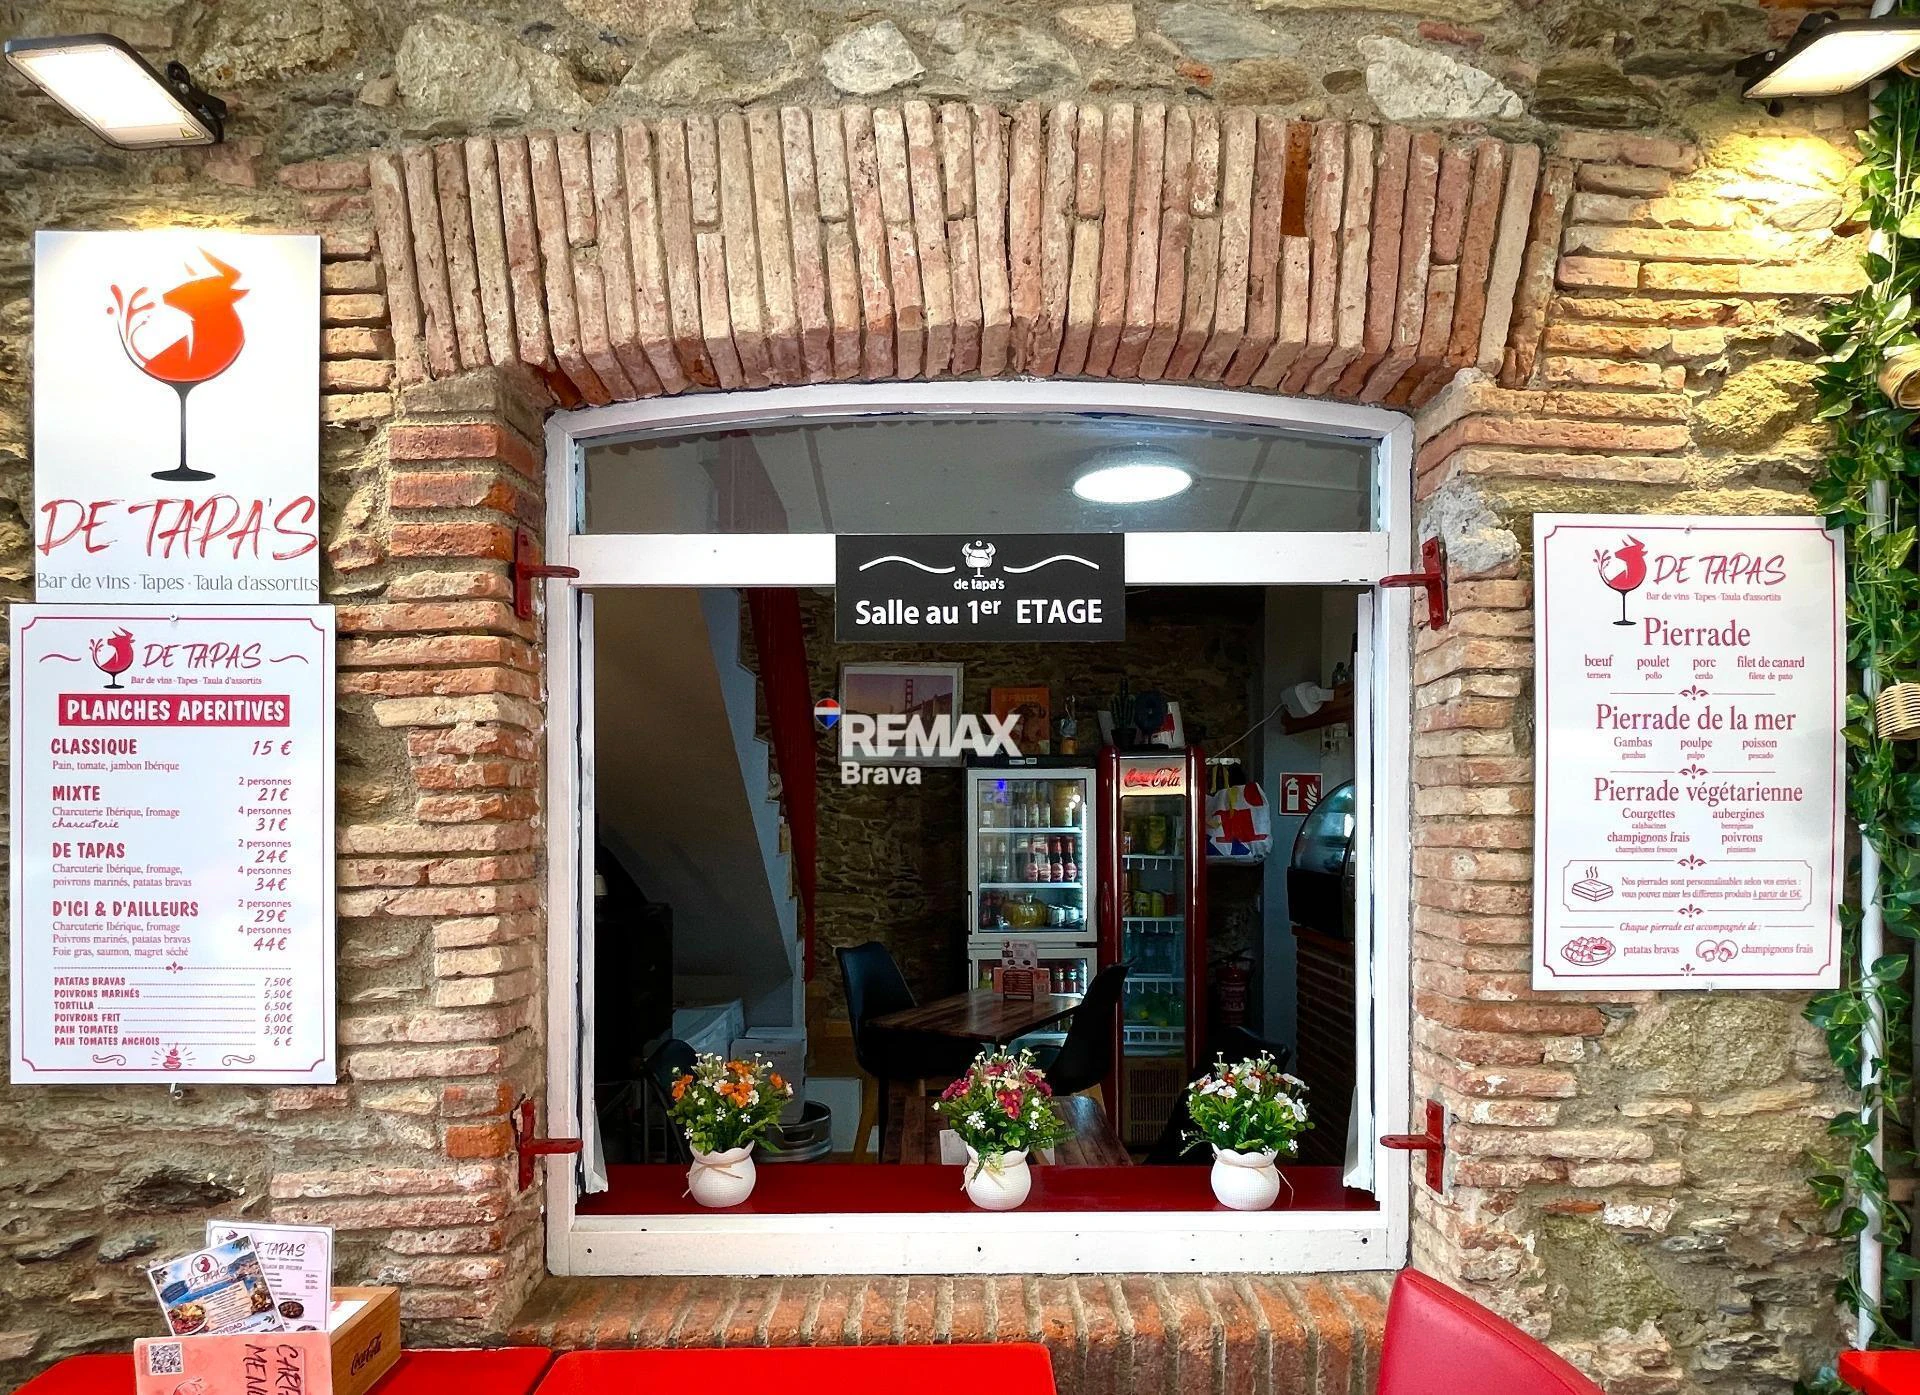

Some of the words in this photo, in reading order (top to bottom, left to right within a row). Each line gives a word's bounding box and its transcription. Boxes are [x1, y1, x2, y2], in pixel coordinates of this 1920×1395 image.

[37, 498, 125, 556] DE
[128, 494, 318, 560] TAPA'S
[1653, 554, 1695, 585] DE
[1698, 552, 1787, 586] TAPAS
[37, 573, 67, 589] Bar
[72, 573, 91, 590] de
[96, 574, 130, 590] vins
[138, 573, 184, 593] Tapes
[194, 574, 233, 591] Taula
[238, 575, 319, 592] d'assortits
[953, 578, 969, 590] de
[971, 578, 1005, 591] tapa's
[1646, 592, 1660, 600] Bar
[1661, 592, 1672, 600] de
[1673, 592, 1690, 600] vins
[1694, 592, 1716, 602] Tapes
[1720, 593, 1741, 601] Taula
[1742, 593, 1781, 601] d'assortits
[855, 600, 919, 625] Salle
[926, 605, 959, 624] au
[967, 599, 1002, 624] 1er
[1016, 599, 1103, 624] ETAGE
[1643, 617, 1750, 647] Pierrade
[143, 644, 178, 668] DE
[183, 642, 262, 669] TAPAS
[1637, 655, 1669, 669] poulet
[1693, 657, 1716, 669] porc
[1737, 656, 1756, 667] filet
[1758, 656, 1770, 668] de
[1772, 656, 1805, 668] canard
[131, 676, 144, 685] Bar
[146, 676, 155, 685] de
[157, 677, 172, 685] vins
[177, 677, 198, 686] Tapes
[203, 677, 223, 686] Taula
[225, 677, 262, 686] d'assortits
[1645, 672, 1662, 680] pollo
[1749, 672, 1766, 680] filete
[1768, 672, 1776, 680] de
[67, 699, 170, 721] PLANCHES
[178, 699, 285, 721] APERITIVES
[1596, 704, 1690, 730] Pierrade
[1697, 705, 1723, 730] de
[1730, 706, 1747, 730] la
[1754, 712, 1796, 730] mer
[51, 738, 137, 755] CLASSIQUE
[252, 740, 273, 755] 15
[281, 740, 292, 755] €
[1614, 737, 1652, 747] Gambas
[1680, 738, 1713, 750] poulpe
[1742, 738, 1777, 750] poisson
[52, 761, 75, 771] Pain,
[77, 761, 108, 771] tomate,
[109, 761, 142, 771] jambon
[144, 760, 180, 771] Ibérique
[239, 777, 244, 785] 2
[247, 778, 291, 786] personnes
[52, 785, 100, 801] MIXTE
[1594, 777, 1679, 802] Pierrade
[1686, 782, 1803, 807] végétarienne
[52, 807, 103, 816] Charcuterie
[106, 807, 143, 818] Ibérique,
[146, 807, 180, 818] fromage
[238, 806, 244, 814] 4
[247, 808, 291, 816] personnes
[1622, 808, 1675, 820] Courgettes
[1713, 808, 1764, 821] aubergines
[52, 818, 119, 828] charcuterie
[1607, 832, 1667, 844] champignons
[1670, 832, 1690, 842] frais
[1721, 833, 1763, 844] poivrons
[238, 839, 243, 847] 2
[247, 840, 291, 849] personnes
[52, 842, 71, 858] DE
[77, 842, 125, 858] TAPAS
[52, 864, 103, 873] Charcuterie
[106, 864, 143, 875] Ibérique,
[146, 864, 182, 875] fromage,
[238, 866, 243, 874] 4
[247, 867, 291, 875] personnes
[53, 877, 91, 888] poivrons
[93, 877, 130, 887] marinés,
[133, 878, 162, 888] patatas
[165, 877, 192, 886] bravas
[52, 901, 88, 917] D'ICI
[95, 901, 106, 917] &
[113, 901, 198, 917] D'AILLEURS
[247, 900, 291, 908] personnes
[52, 921, 103, 931] Charcuterie
[146, 922, 180, 932] fromage
[247, 926, 291, 935] personnes
[1620, 923, 1648, 932] Chaque
[1650, 923, 1681, 932] pierrade
[1696, 923, 1745, 933] accompagnée
[1748, 923, 1756, 931] de
[53, 934, 91, 943] Poivrons
[132, 934, 161, 945] patatas
[164, 934, 191, 943] bravas
[53, 947, 71, 956] Foie
[74, 948, 94, 958] gras,
[1624, 946, 1651, 956] patatas
[1654, 945, 1679, 954] bravas
[1742, 945, 1793, 955] champignons
[1796, 945, 1813, 954] frais
[54, 977, 90, 986] PATATAS
[92, 977, 126, 986] BRAVAS
[264, 978, 293, 987] 7,50€
[54, 989, 98, 998] POIVRONS
[264, 990, 293, 999] 5,50€
[54, 1001, 94, 1010] TORTILLA
[264, 1002, 293, 1011] 6,50€
[54, 1013, 98, 1022] POIVRONS
[101, 1013, 121, 1022] FRIT
[264, 1014, 293, 1023] 6,00€
[54, 1025, 76, 1034] PAIN
[78, 1025, 119, 1034] TOMATES
[264, 1026, 293, 1035] 3,90€
[54, 1037, 75, 1046] PAIN
[78, 1037, 118, 1046] TOMATES
[121, 1037, 160, 1046] ANCHOIS
[273, 1037, 280, 1046] 6
[285, 1037, 293, 1046] €
[265, 1242, 305, 1257] TAPAS
